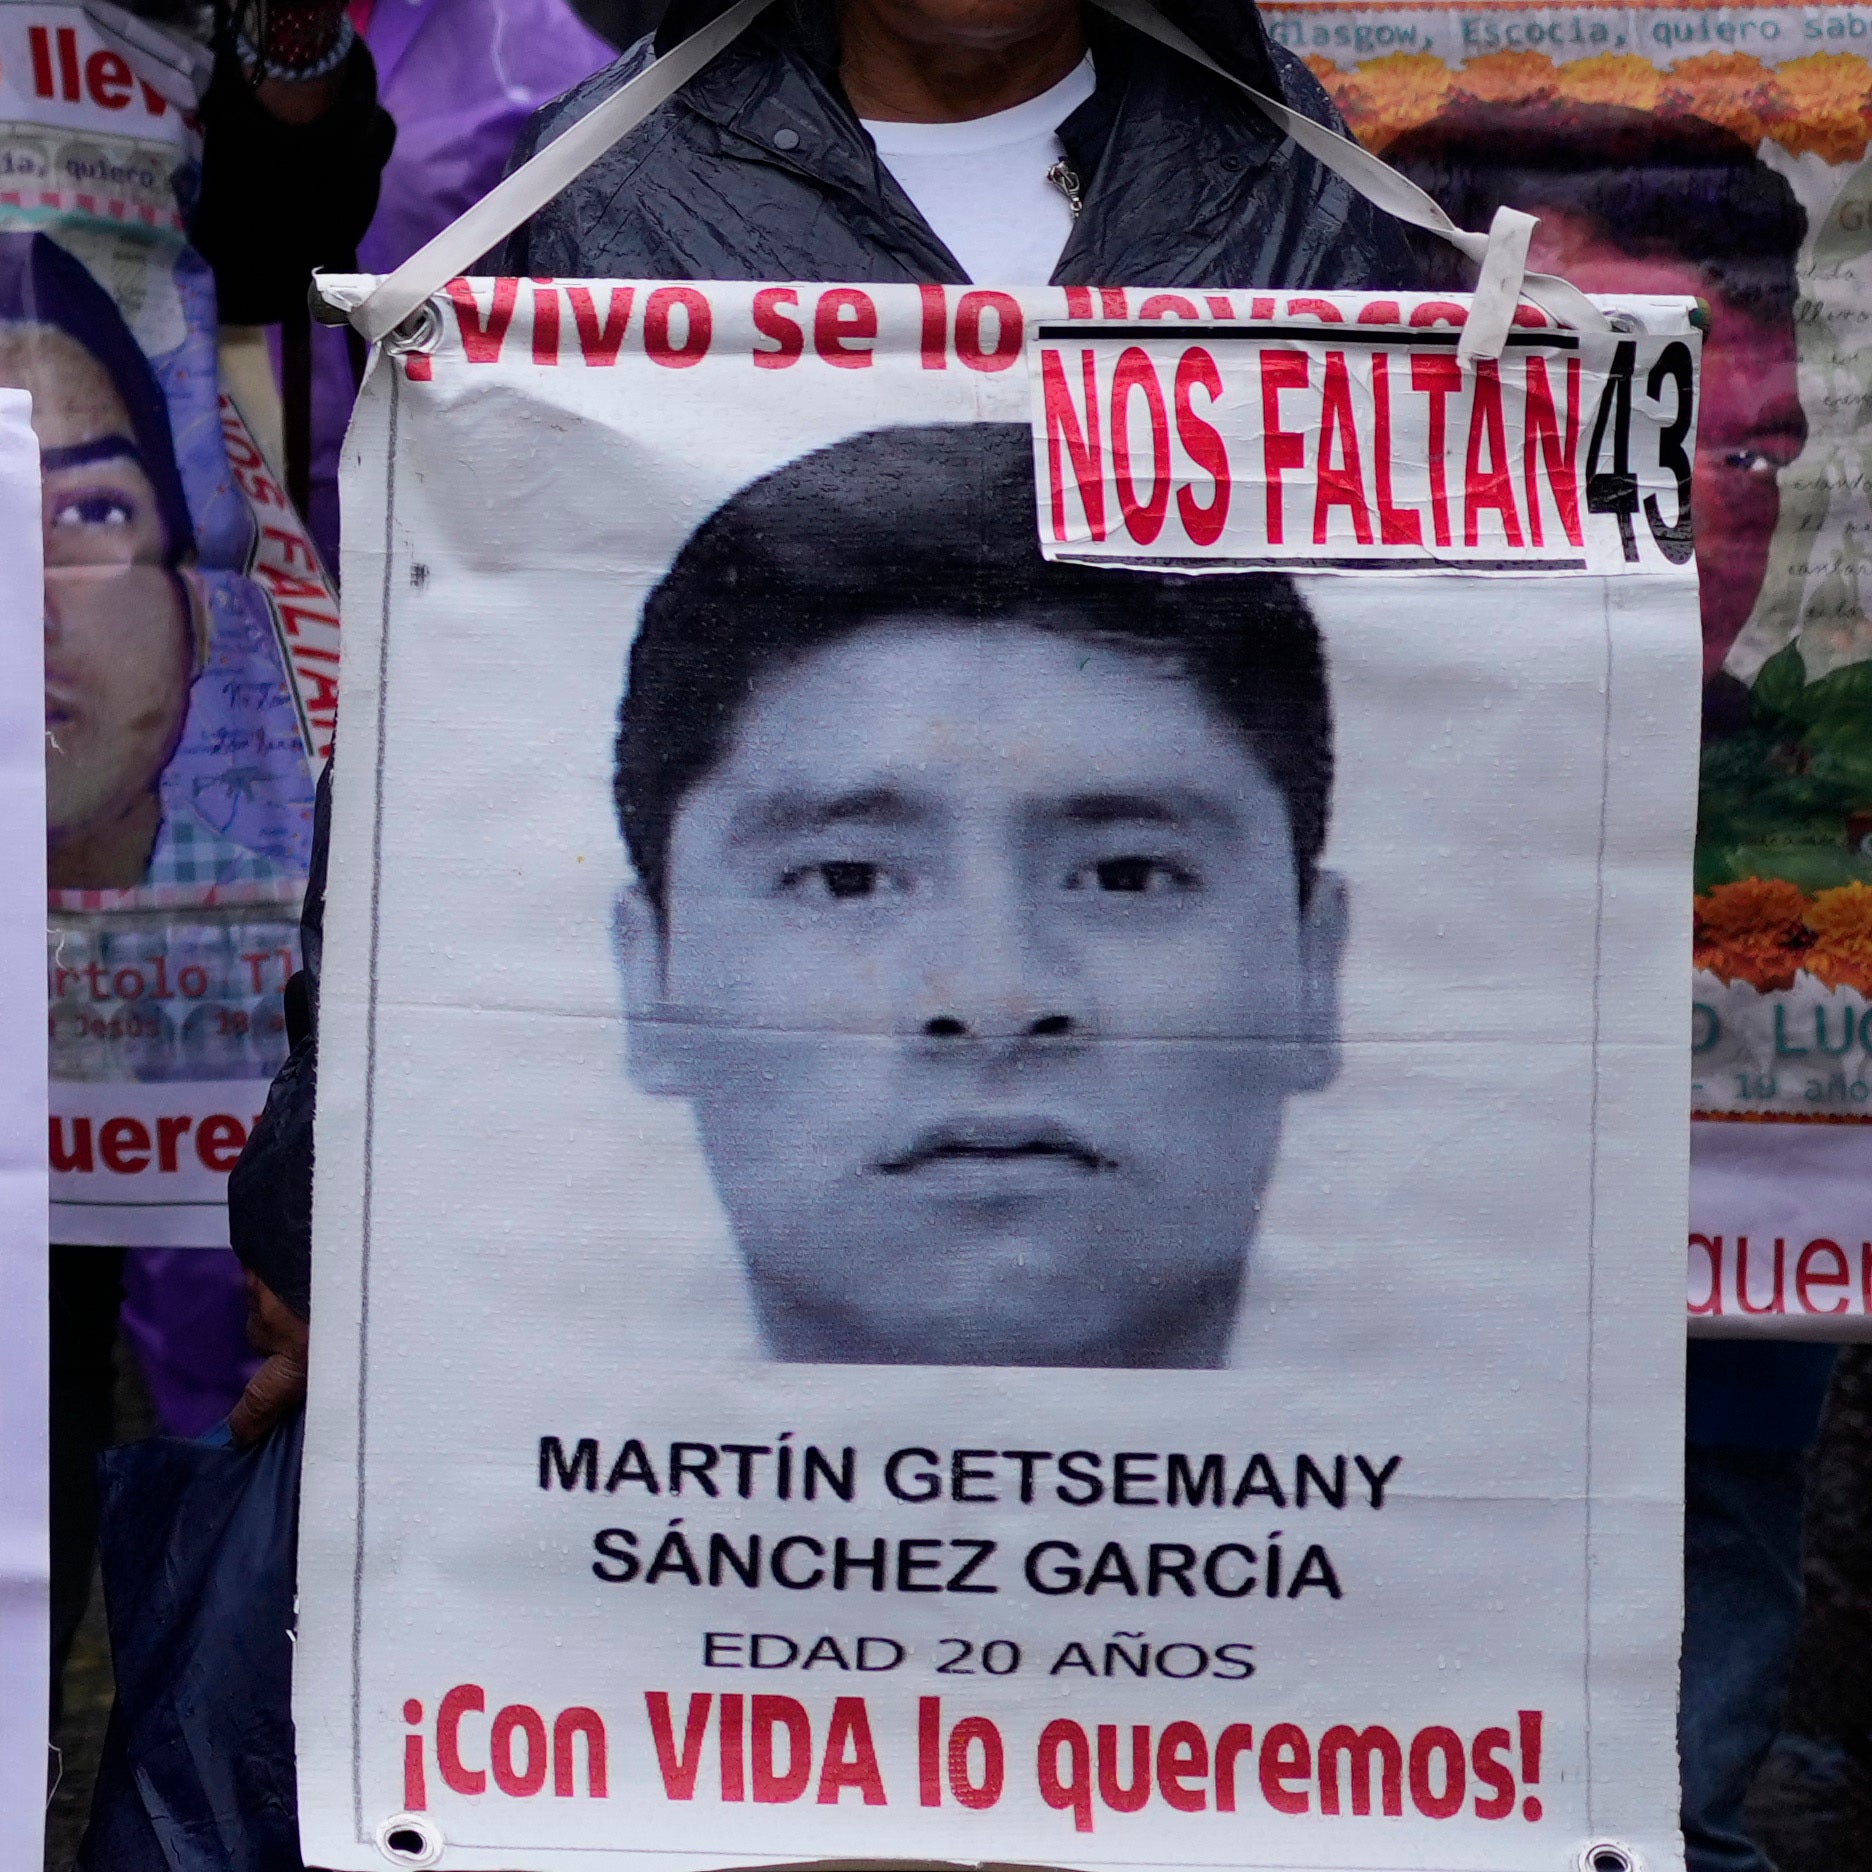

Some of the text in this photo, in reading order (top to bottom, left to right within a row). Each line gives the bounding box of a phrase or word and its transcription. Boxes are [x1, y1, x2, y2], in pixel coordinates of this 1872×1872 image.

[752, 286, 878, 370] se
[920, 283, 1024, 373] lo
[1041, 345, 1232, 546] NOS
[538, 1431, 1402, 1511] MARTÍN GETSEMANY
[591, 1517, 1344, 1601] SÁNCHEZ GARCÍA
[703, 1630, 1256, 1680] EDAD 20 AÑOS
[402, 1683, 1543, 1834] ¡Con VIDA lo queremos!
